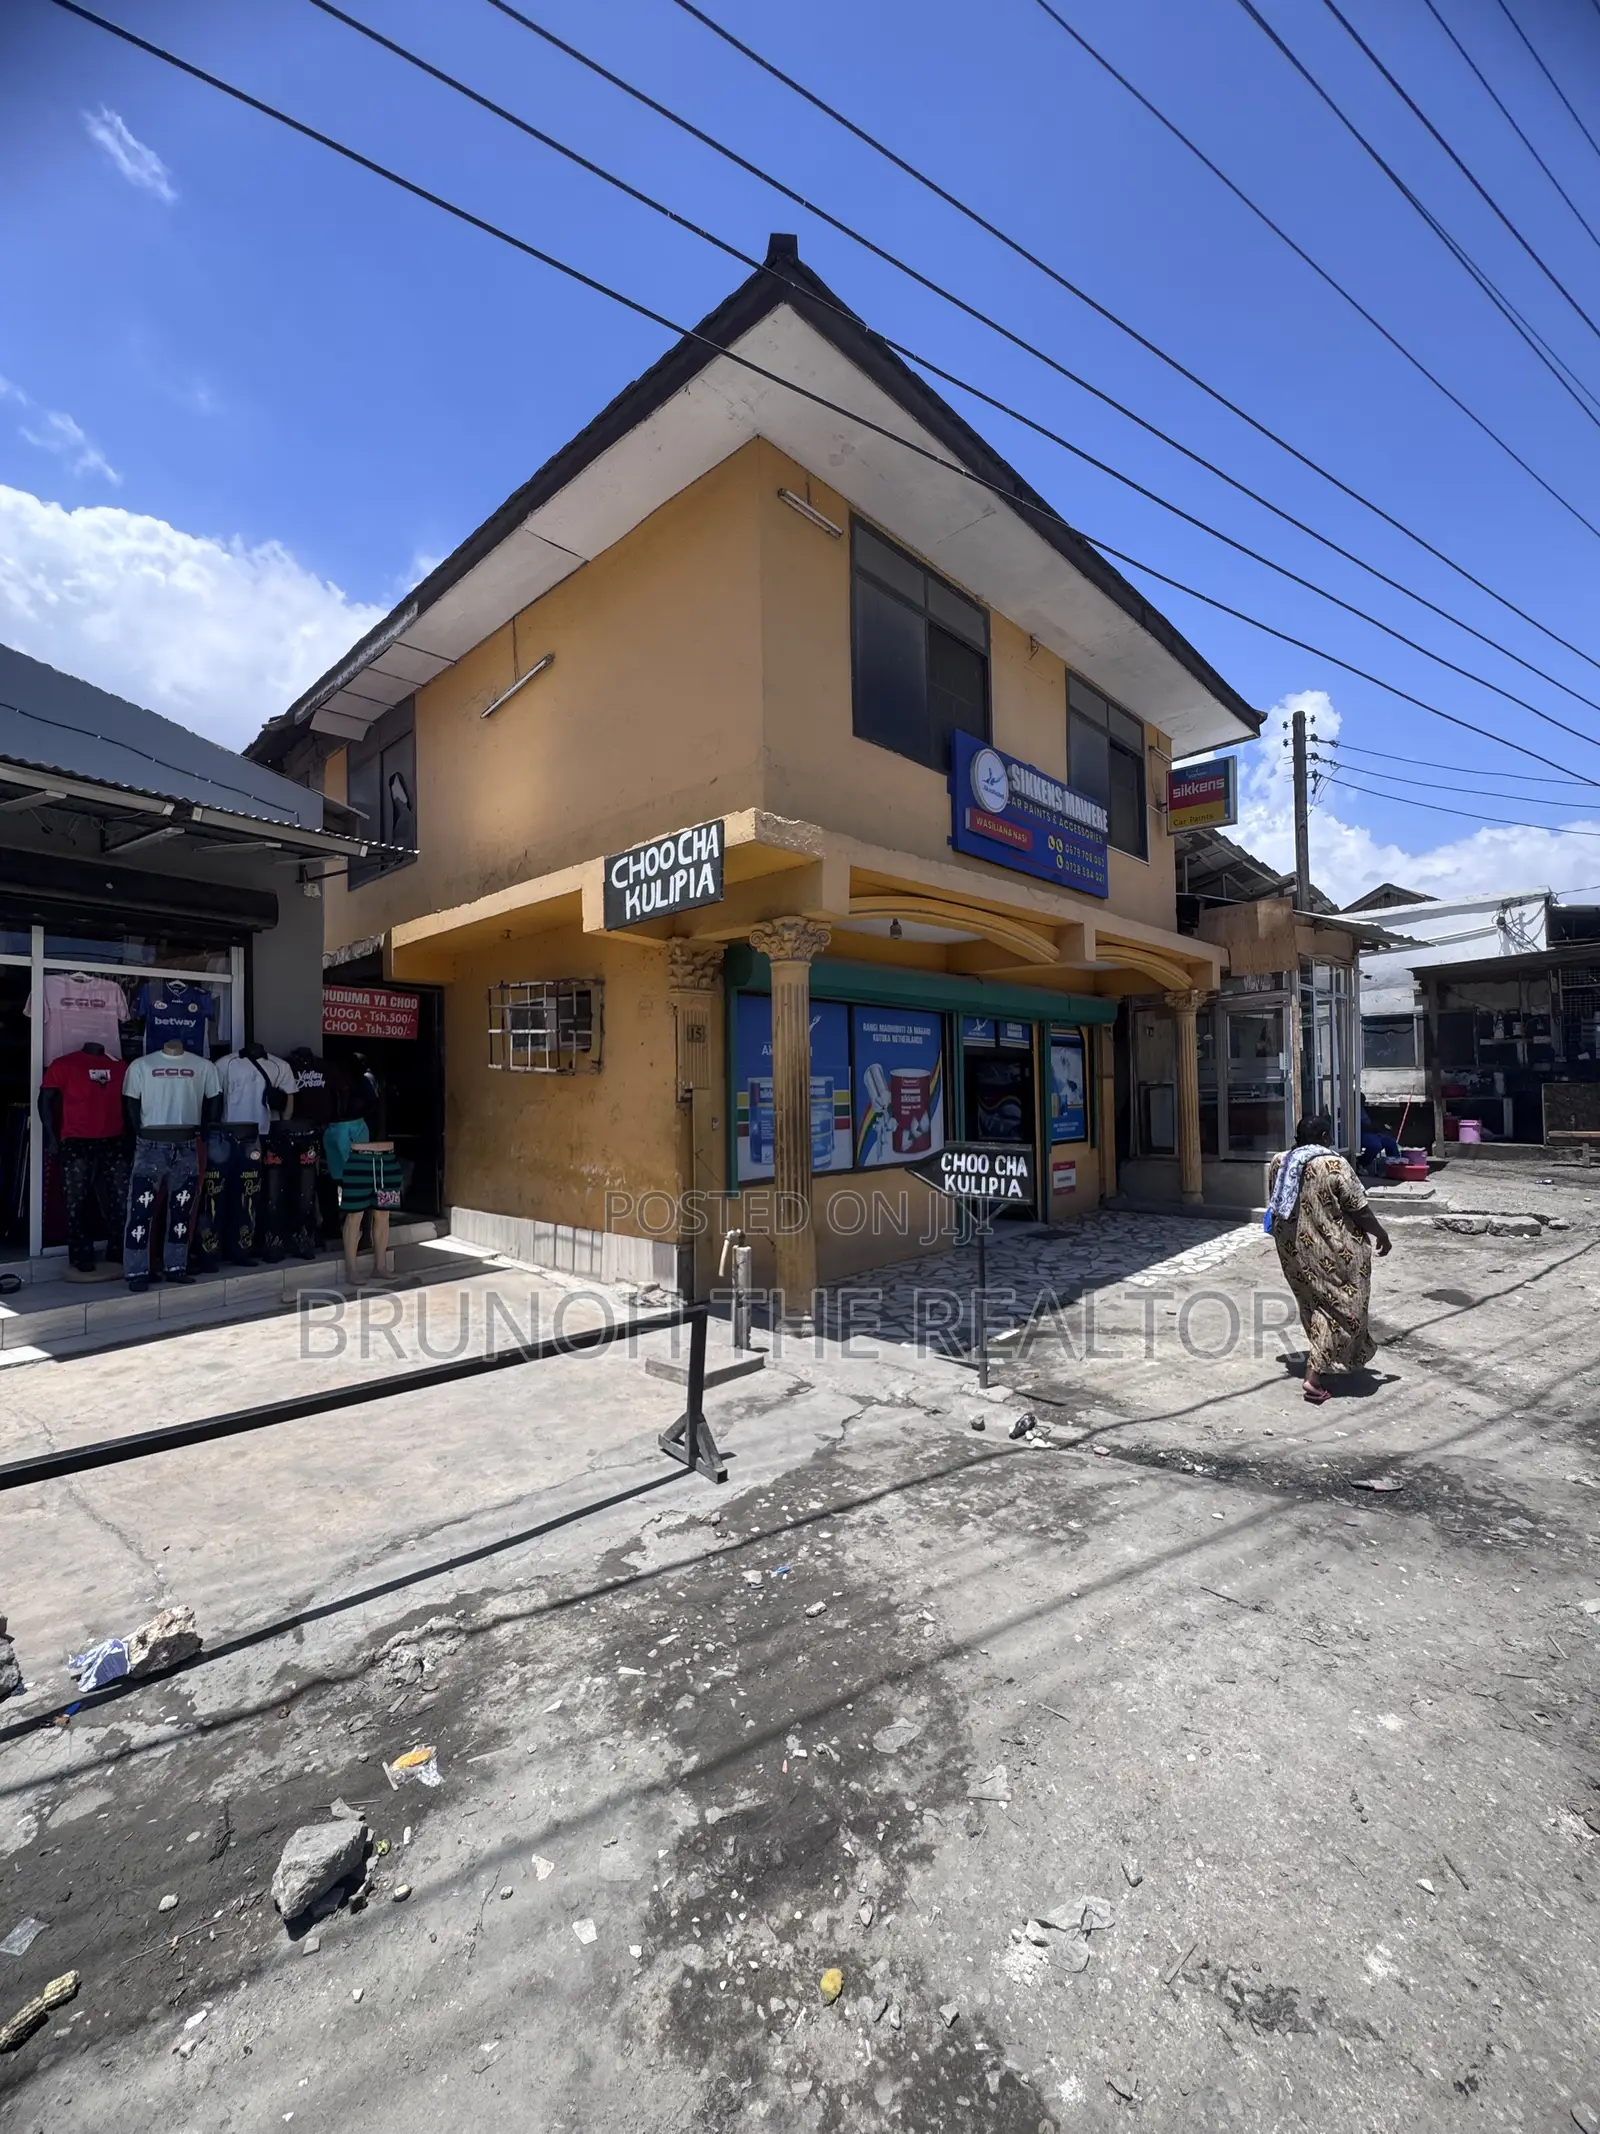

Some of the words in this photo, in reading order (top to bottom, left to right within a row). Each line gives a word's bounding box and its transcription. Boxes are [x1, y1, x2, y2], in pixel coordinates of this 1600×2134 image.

[1008, 763, 1063, 812] SIKKENS
[1062, 790, 1108, 833] MAWERE
[1172, 777, 1225, 799] sikkens
[1023, 801, 1051, 822] PAINTS
[1058, 818, 1103, 845] ACCESSORIES
[1173, 817, 1187, 827] Car
[1189, 812, 1214, 823] Paints
[611, 840, 675, 889] CHOO
[677, 824, 720, 865] CHA
[625, 862, 715, 920] KULIPIA
[322, 988, 370, 1005] HUDUMA
[374, 994, 387, 1007] YA
[390, 996, 418, 1010] CHOO
[154, 1016, 197, 1028] betway
[322, 1006, 361, 1020] KUOGA
[370, 1010, 415, 1024] Tsh.500/-
[324, 1019, 358, 1032] CHOO
[365, 1022, 411, 1037] Tsh.300/-
[691, 1027, 702, 1040] 15
[941, 1152, 990, 1175] CHOO
[994, 1155, 1028, 1178] CHA
[944, 1173, 1023, 1198] KULIPIA
